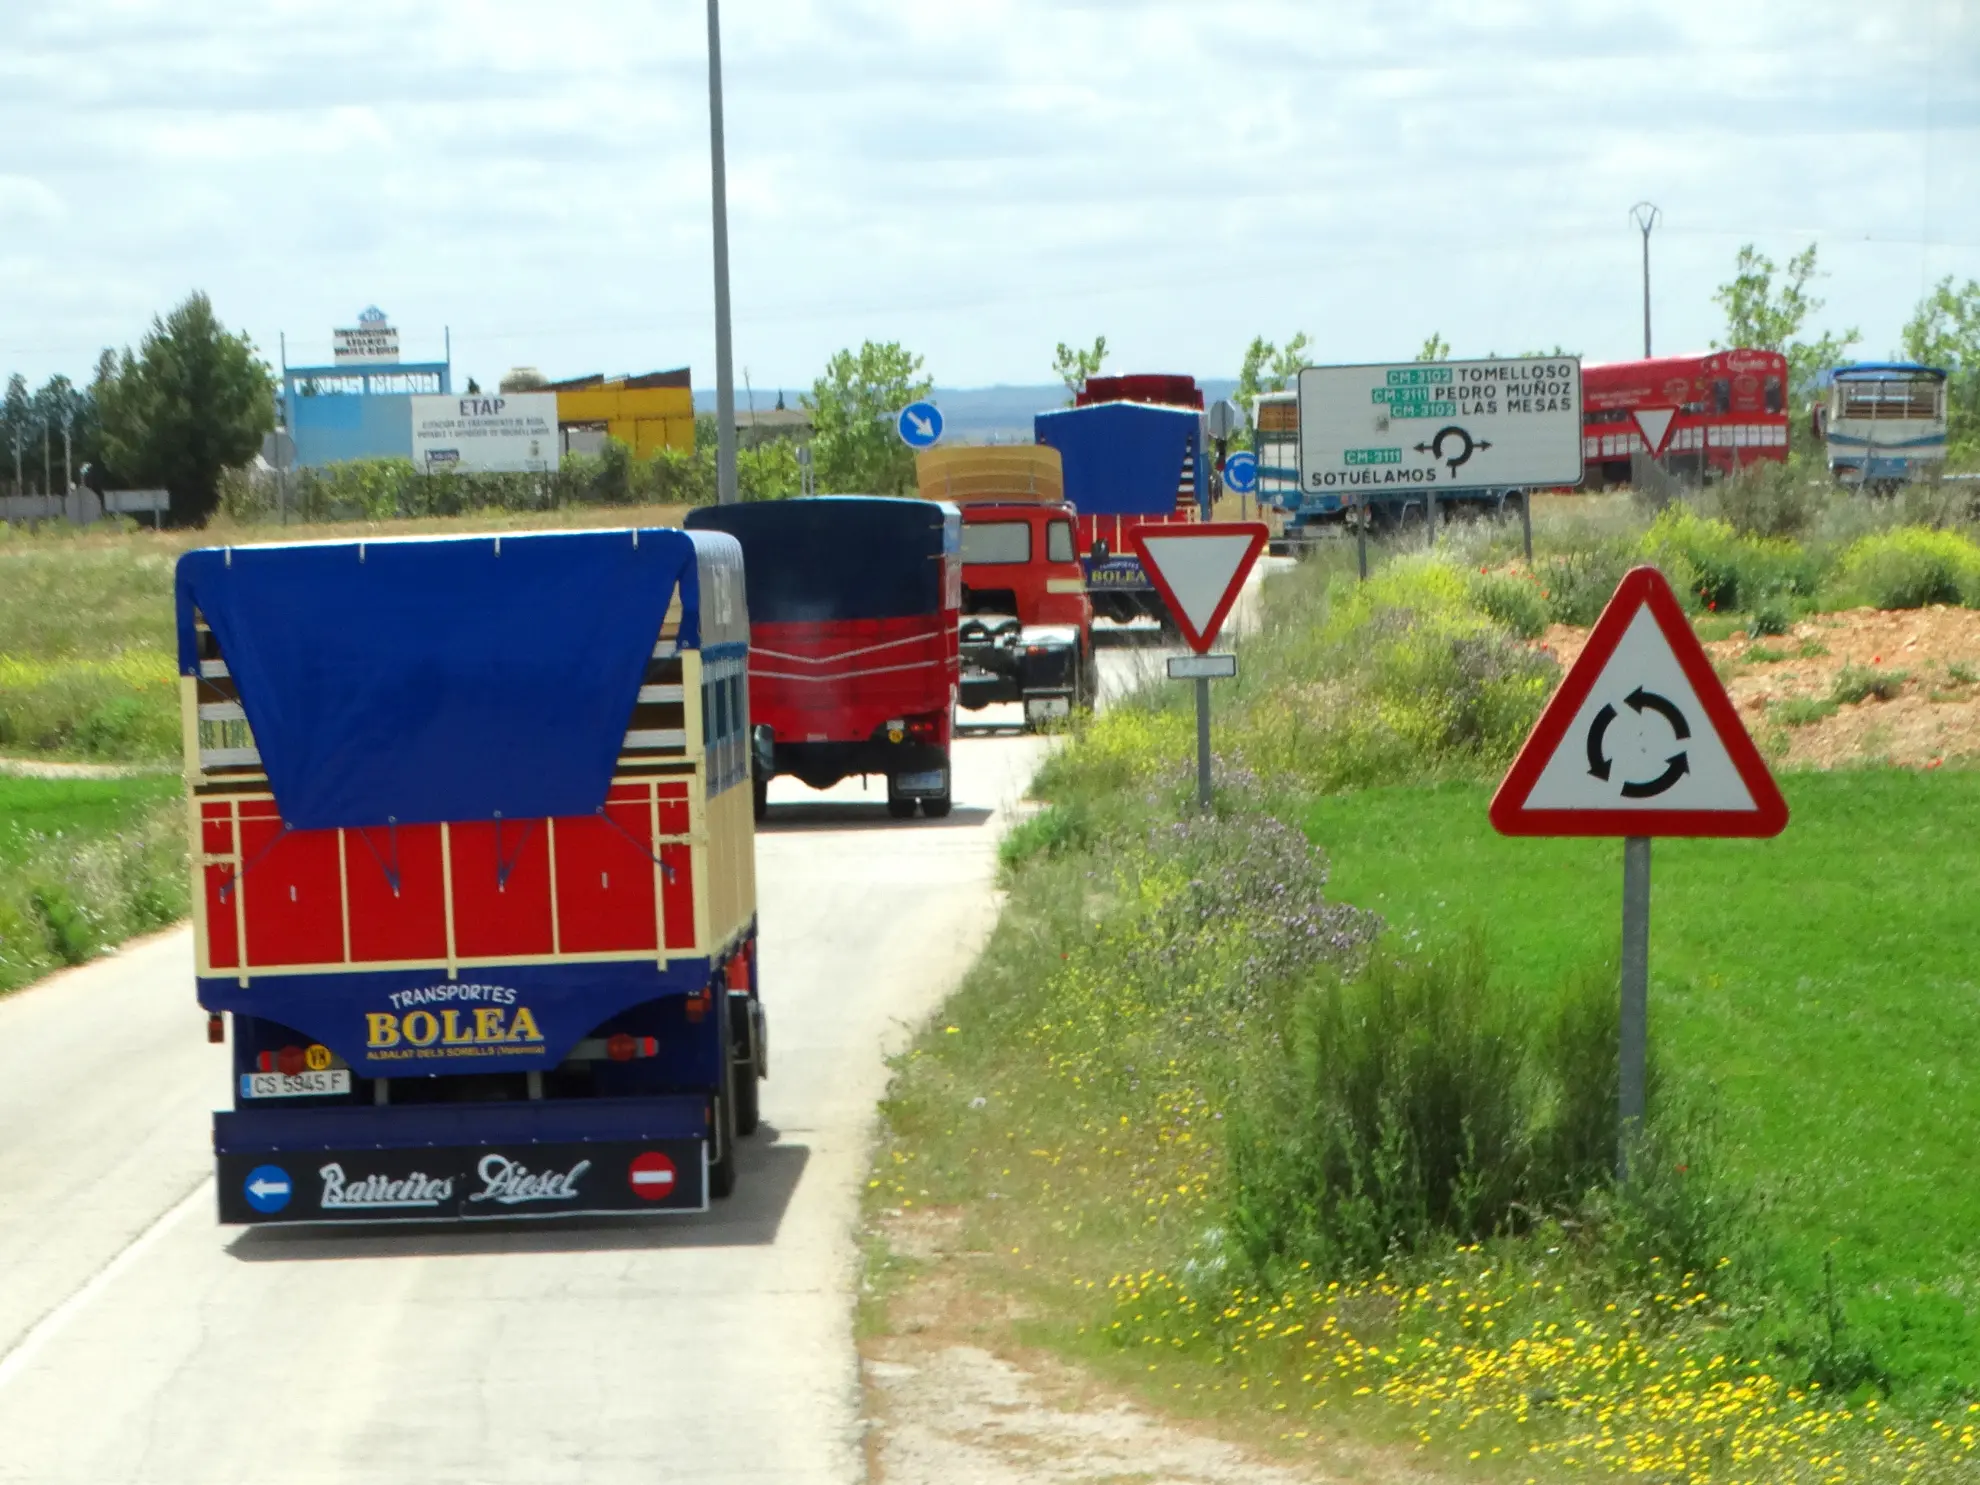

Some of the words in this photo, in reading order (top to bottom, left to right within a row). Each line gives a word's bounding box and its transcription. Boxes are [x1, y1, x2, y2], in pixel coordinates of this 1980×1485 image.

[1458, 364, 1572, 382] TOMELLOSO
[1435, 385, 1497, 401] PEDRO
[1506, 380, 1571, 398] MUÑOZ
[459, 398, 506, 417] ETAP
[1462, 400, 1498, 415] LAS
[1508, 397, 1572, 413] MESAS
[1312, 468, 1437, 487] SOTUÉLAMOS
[1091, 569, 1147, 582] BOLEA
[389, 984, 518, 1010] TRANSPORTES
[365, 1007, 545, 1048] BOLEA
[254, 1075, 277, 1094] CS
[283, 1073, 326, 1093] 5945
[331, 1072, 343, 1091] F
[320, 1162, 454, 1207] Barreiros
[469, 1153, 592, 1204] Diesel
